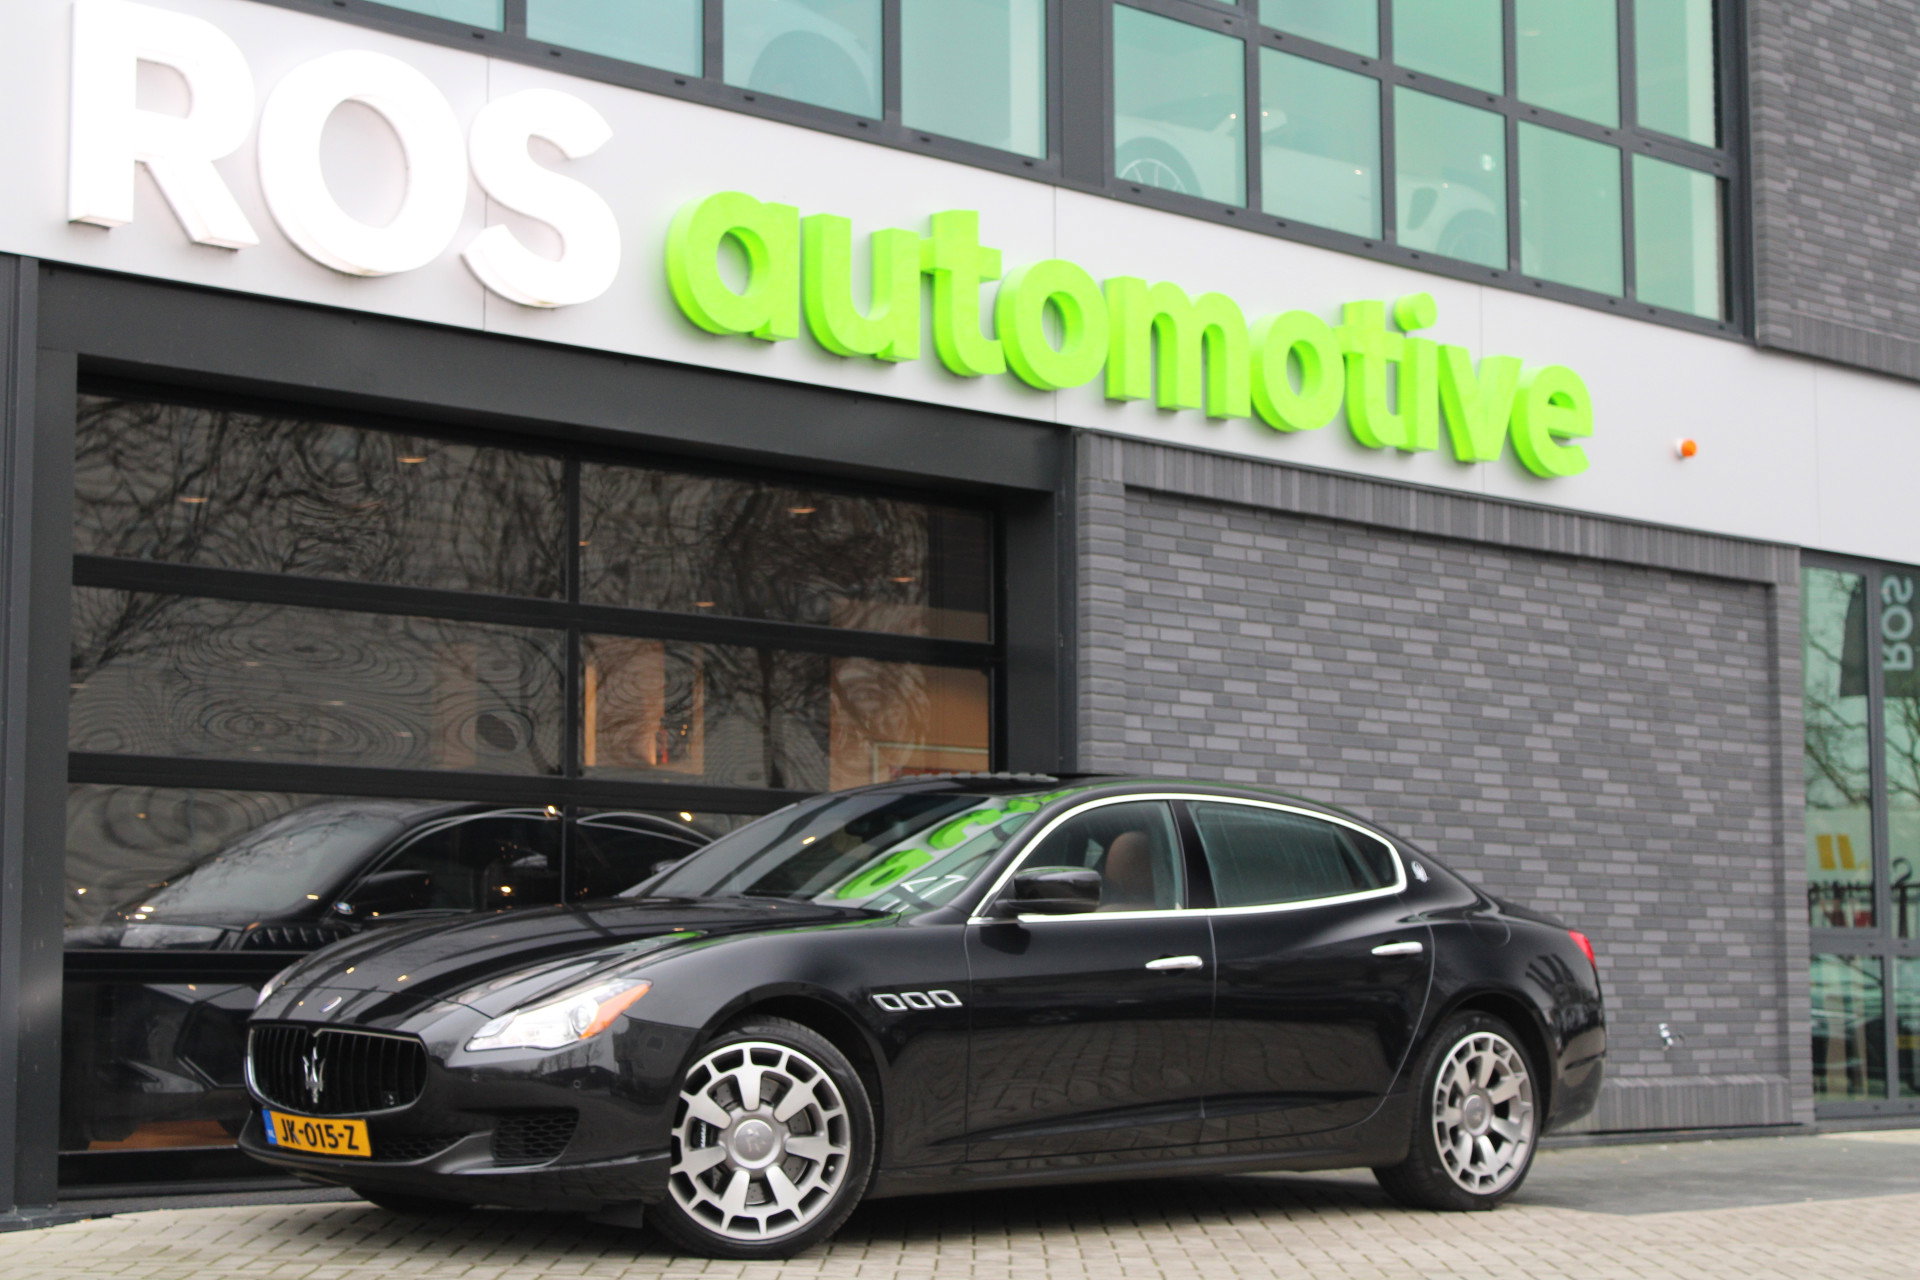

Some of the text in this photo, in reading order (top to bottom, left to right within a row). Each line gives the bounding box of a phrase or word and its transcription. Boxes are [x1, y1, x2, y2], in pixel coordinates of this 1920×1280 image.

[68, 0, 1593, 479] ROS automotive
[281, 1118, 360, 1150] JK-015-Z
